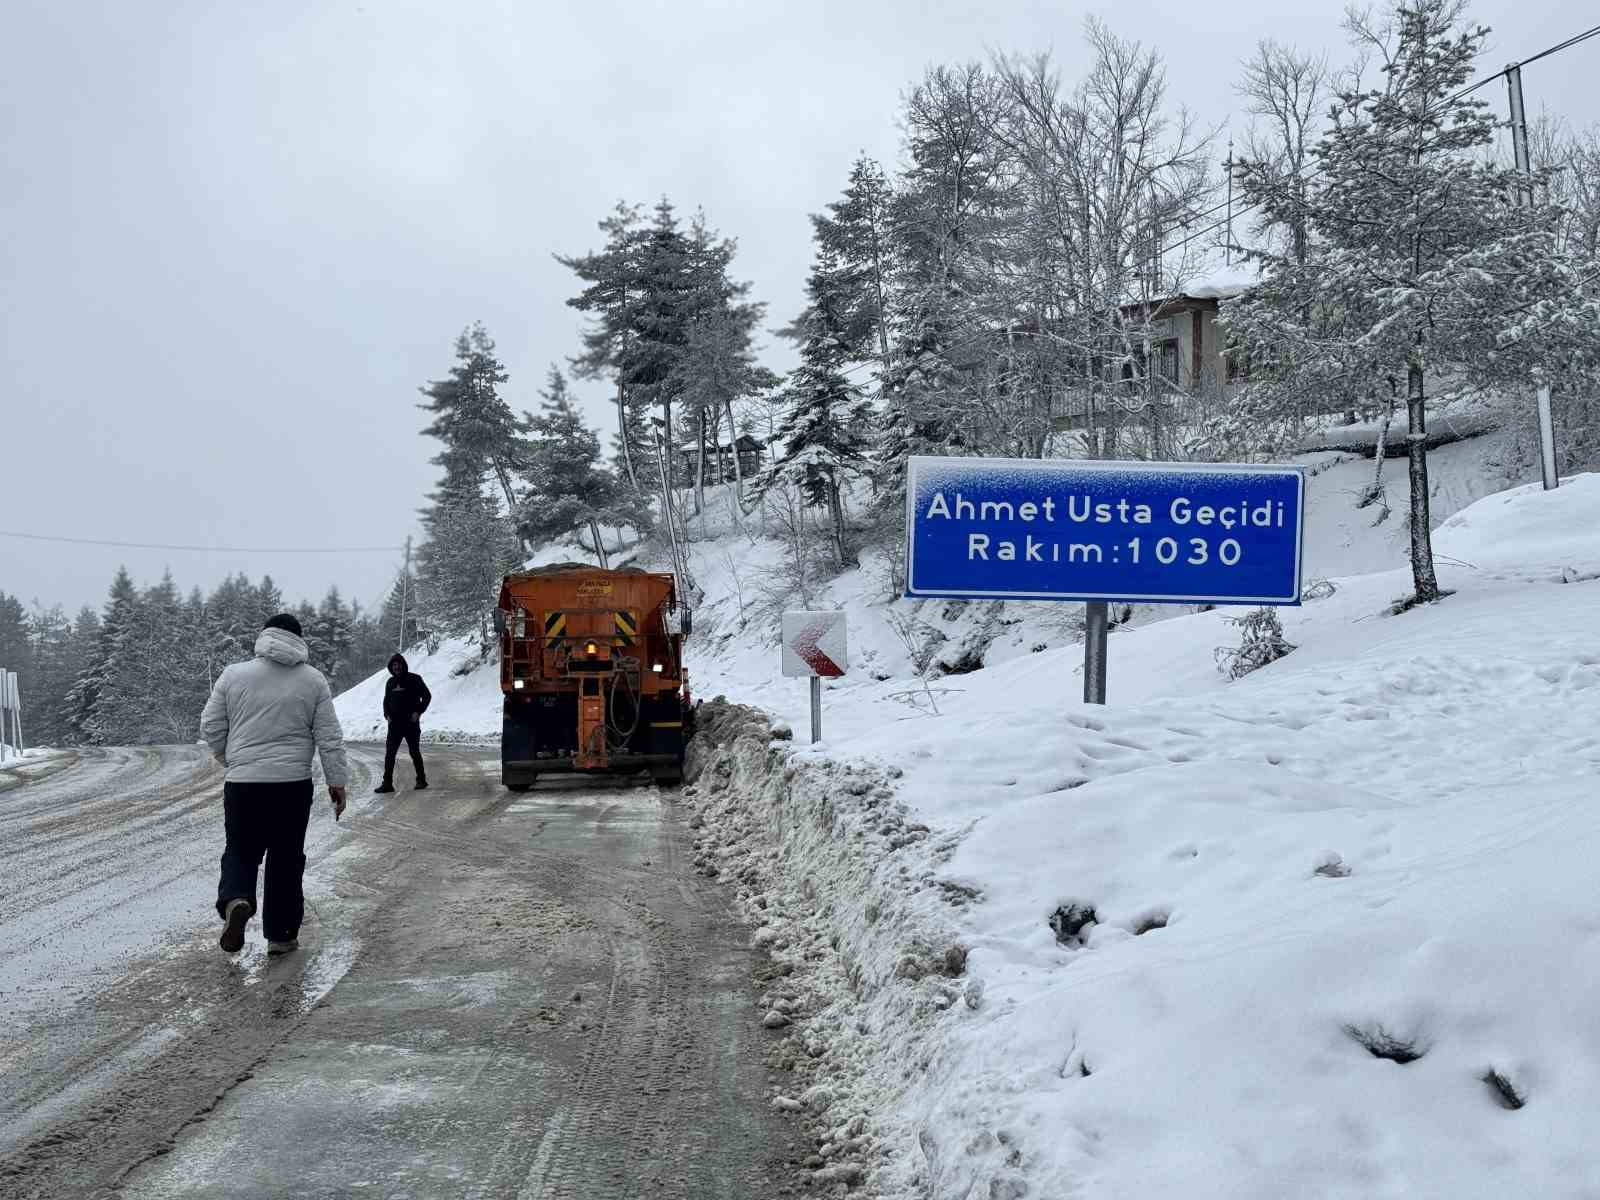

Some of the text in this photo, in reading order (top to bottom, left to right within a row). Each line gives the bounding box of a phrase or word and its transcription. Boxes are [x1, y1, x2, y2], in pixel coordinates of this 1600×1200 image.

[926, 493, 1283, 530] Ahmet Usta Geçidi
